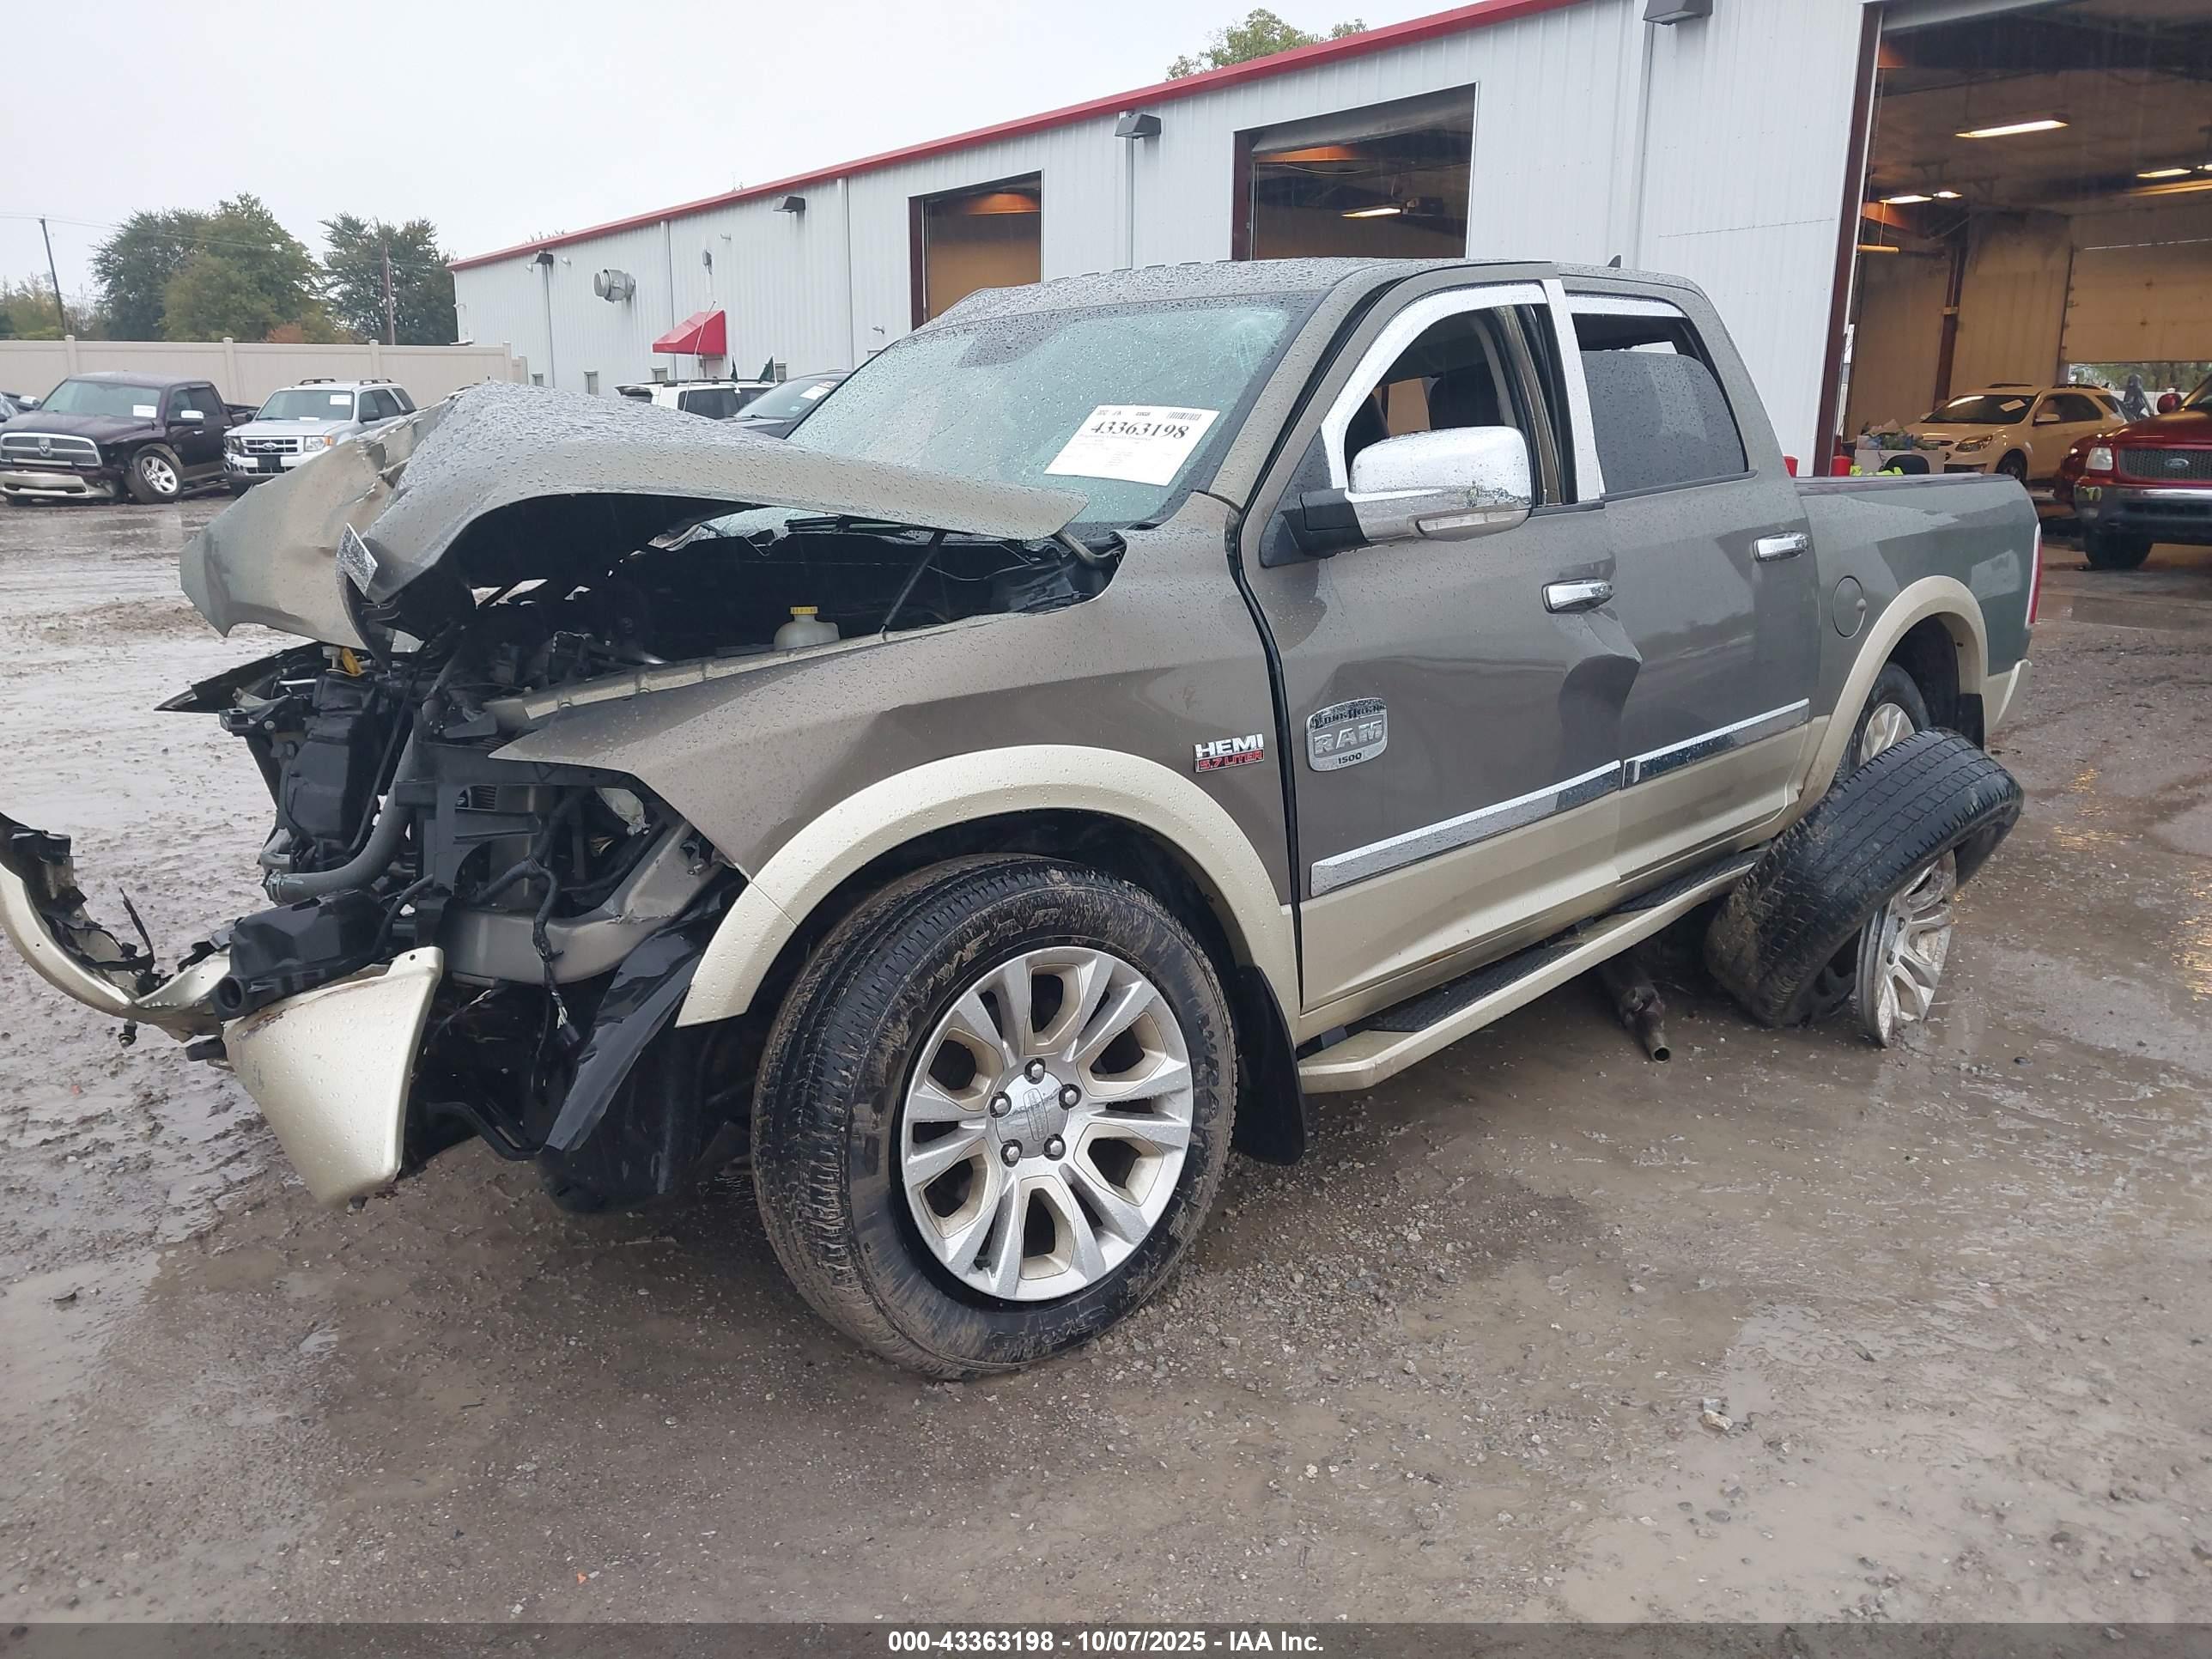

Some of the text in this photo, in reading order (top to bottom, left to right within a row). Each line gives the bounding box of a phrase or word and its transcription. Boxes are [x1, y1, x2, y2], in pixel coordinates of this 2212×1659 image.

[1091, 421, 1189, 440] 43363198
[1195, 733, 1264, 758] HEMI
[1314, 720, 1382, 755] RAM
[1200, 750, 1262, 769] 5.7 LITER
[1338, 752, 1362, 765] 1500
